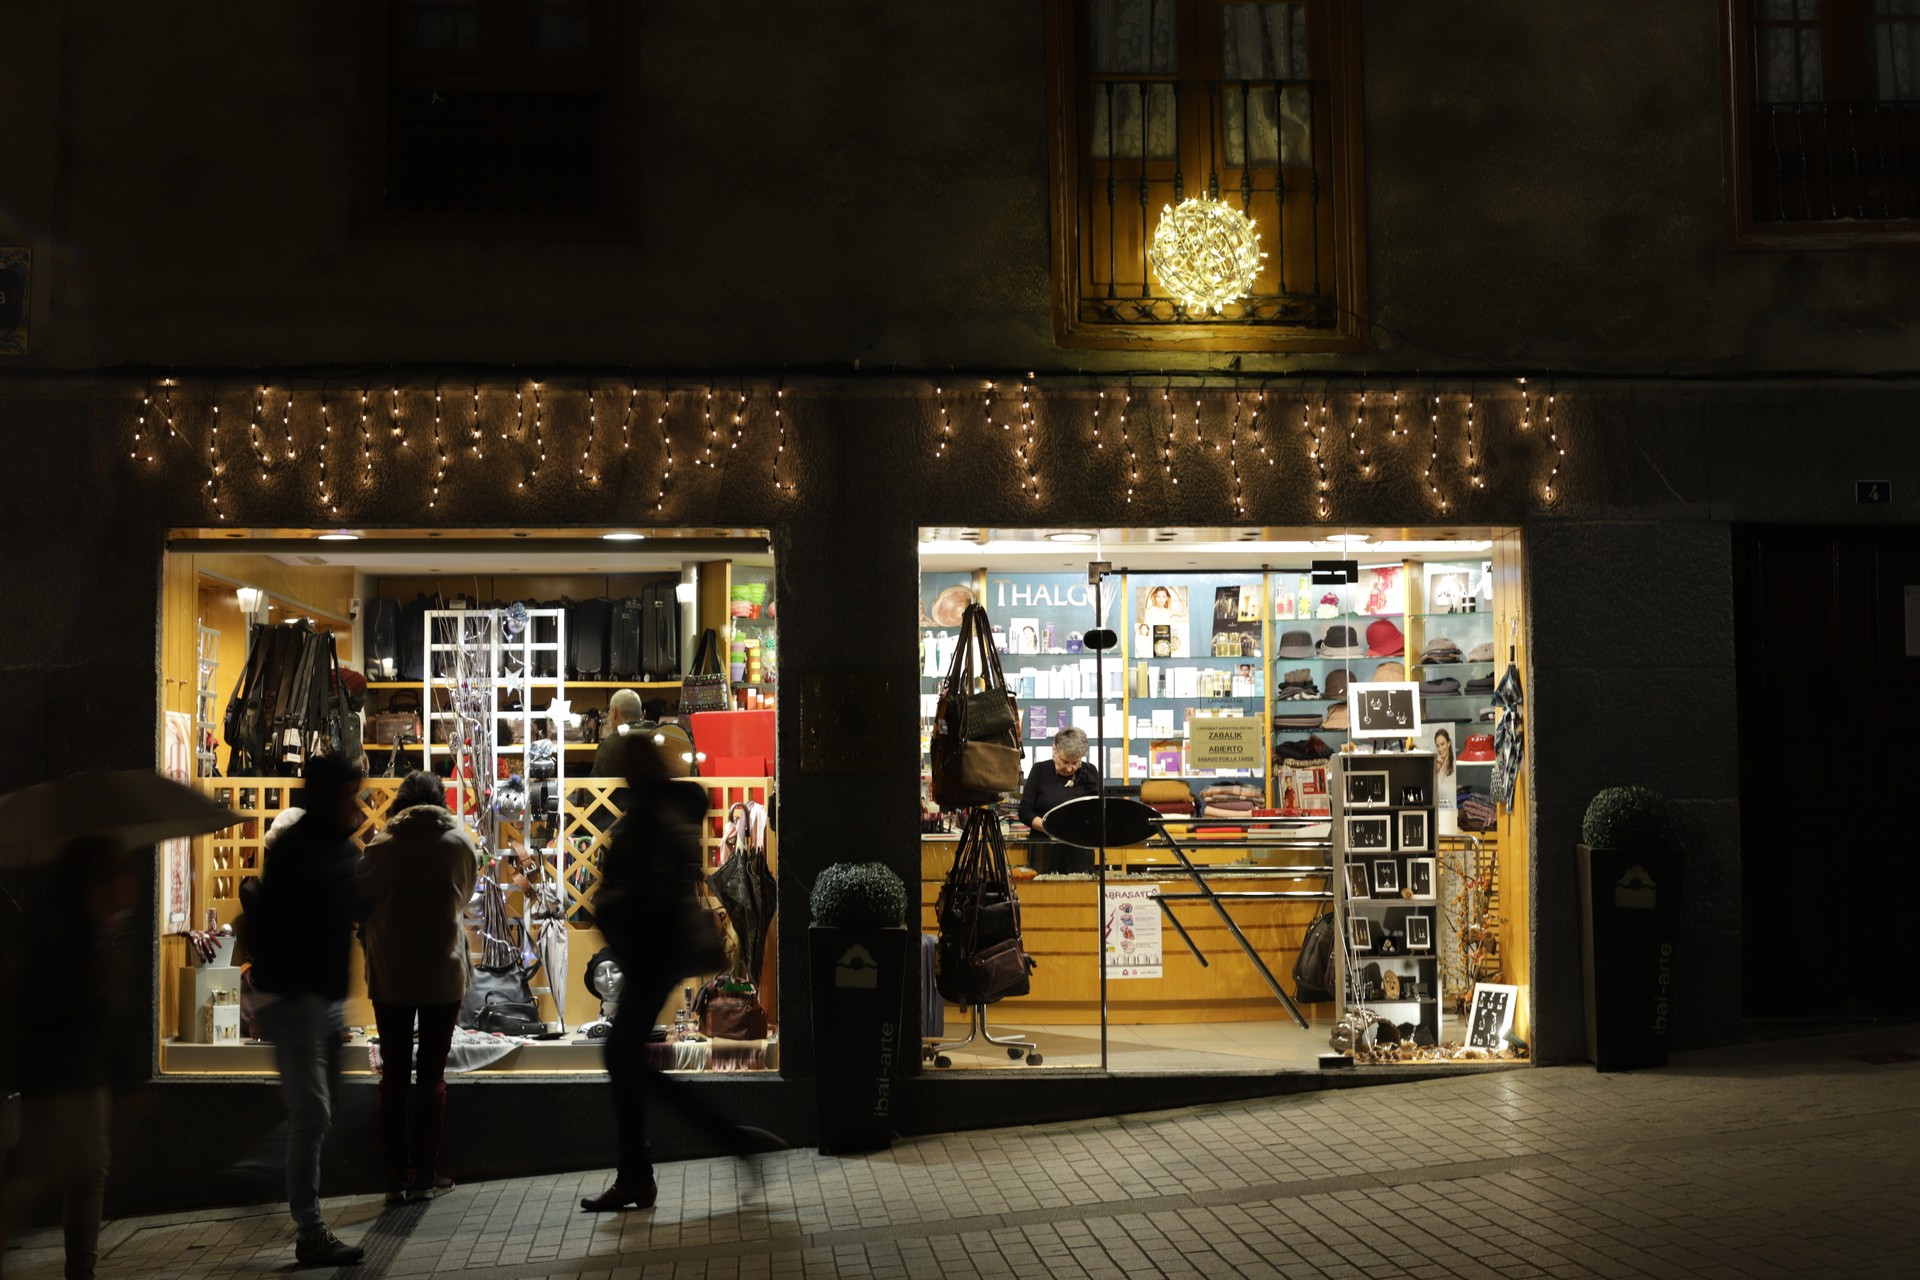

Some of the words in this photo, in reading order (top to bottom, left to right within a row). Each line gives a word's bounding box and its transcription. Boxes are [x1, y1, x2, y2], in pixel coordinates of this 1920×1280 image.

[1868, 483, 1881, 501] 4
[1208, 731, 1243, 739] ZABALIK
[1209, 745, 1244, 753] ABIERTO
[1652, 942, 1673, 1035] ibai-arte
[874, 1022, 895, 1117] ibai-arte
